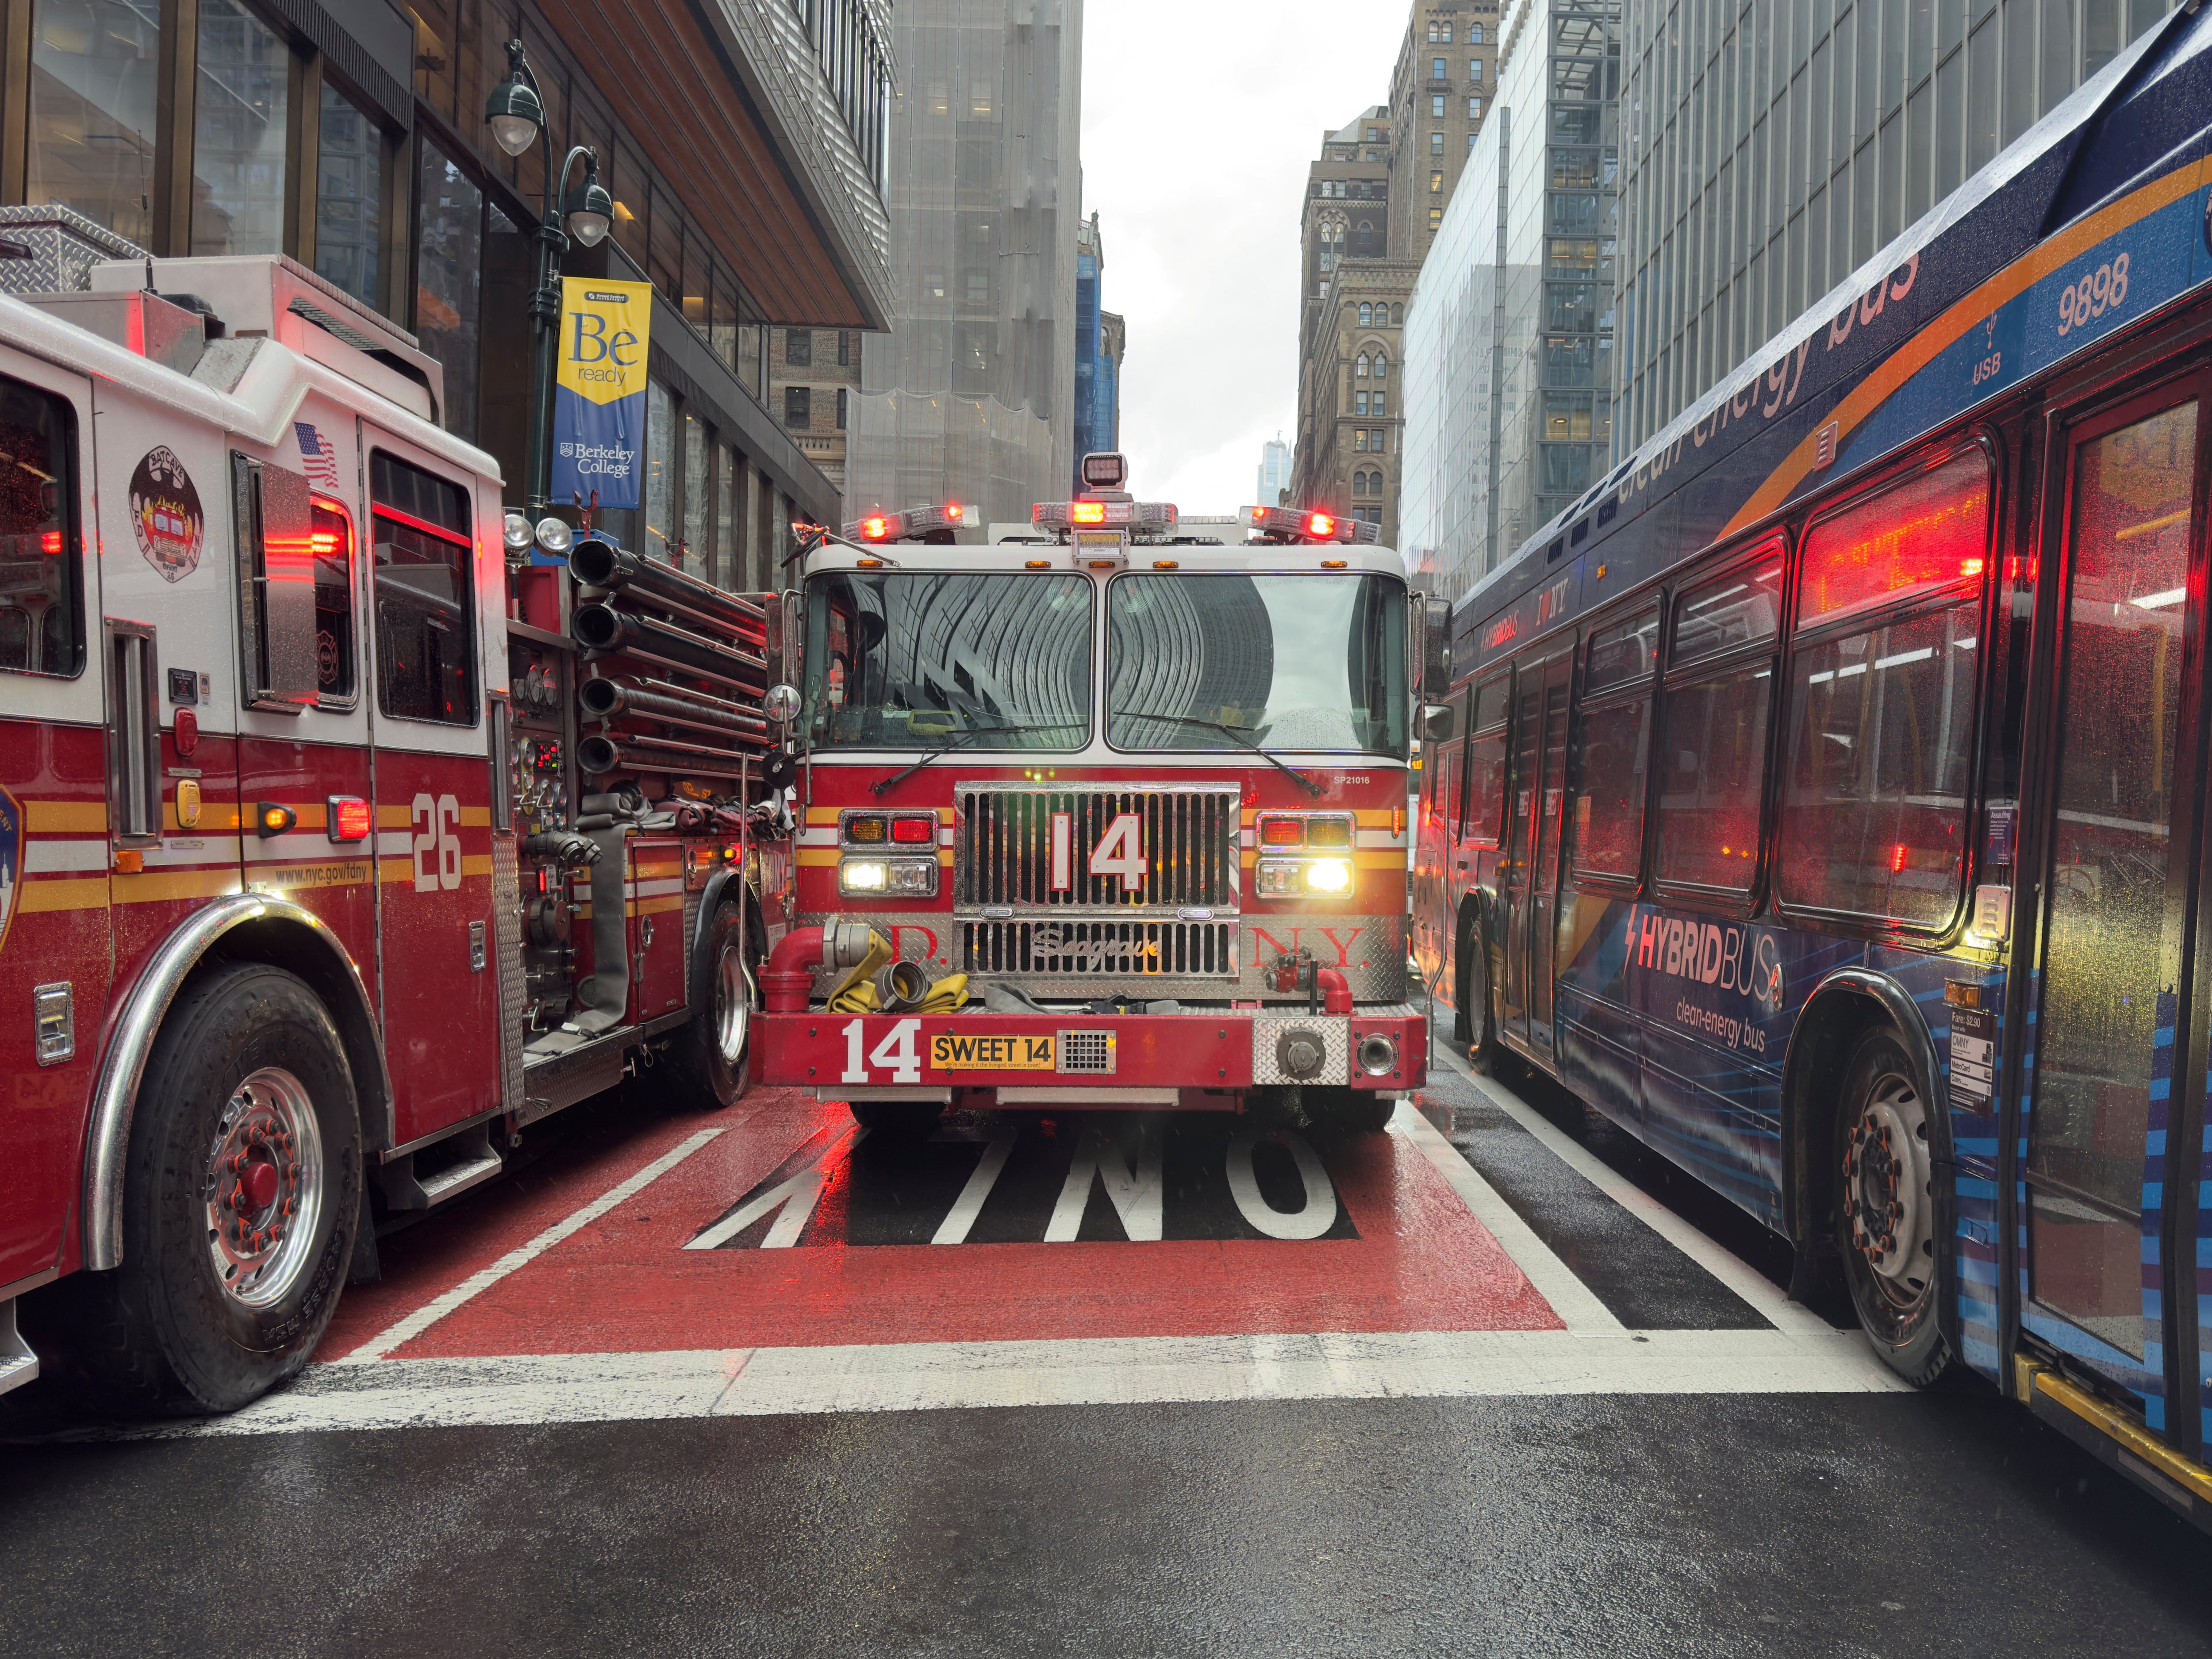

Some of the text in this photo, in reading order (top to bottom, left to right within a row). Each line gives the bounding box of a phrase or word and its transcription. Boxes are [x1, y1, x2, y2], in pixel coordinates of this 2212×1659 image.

[2058, 252, 2130, 336] 9898
[568, 312, 638, 366] Be
[578, 367, 627, 387] ready
[1974, 352, 2001, 385] USB
[150, 450, 184, 477] BATCAVE
[575, 443, 635, 464] Berkeley
[577, 459, 630, 478] College
[162, 562, 177, 573] ENGINE
[167, 572, 174, 581] 26
[1990, 811, 2011, 820] Assaulting
[412, 793, 461, 892] 26
[1051, 813, 1149, 892] 14
[276, 862, 366, 886] www.nyc.gov/fdny
[1030, 929, 1161, 971] Seagrave
[1676, 997, 1765, 1052] clean-energy bus
[1952, 1011, 1981, 1028] Fare: $2.90
[841, 1019, 921, 1083] 14
[935, 1037, 1051, 1062] SWEET 14
[1952, 1035, 1969, 1049] OMNY
[1951, 1060, 1970, 1072] MetroCard
[1951, 1075, 1961, 1084] Coins
